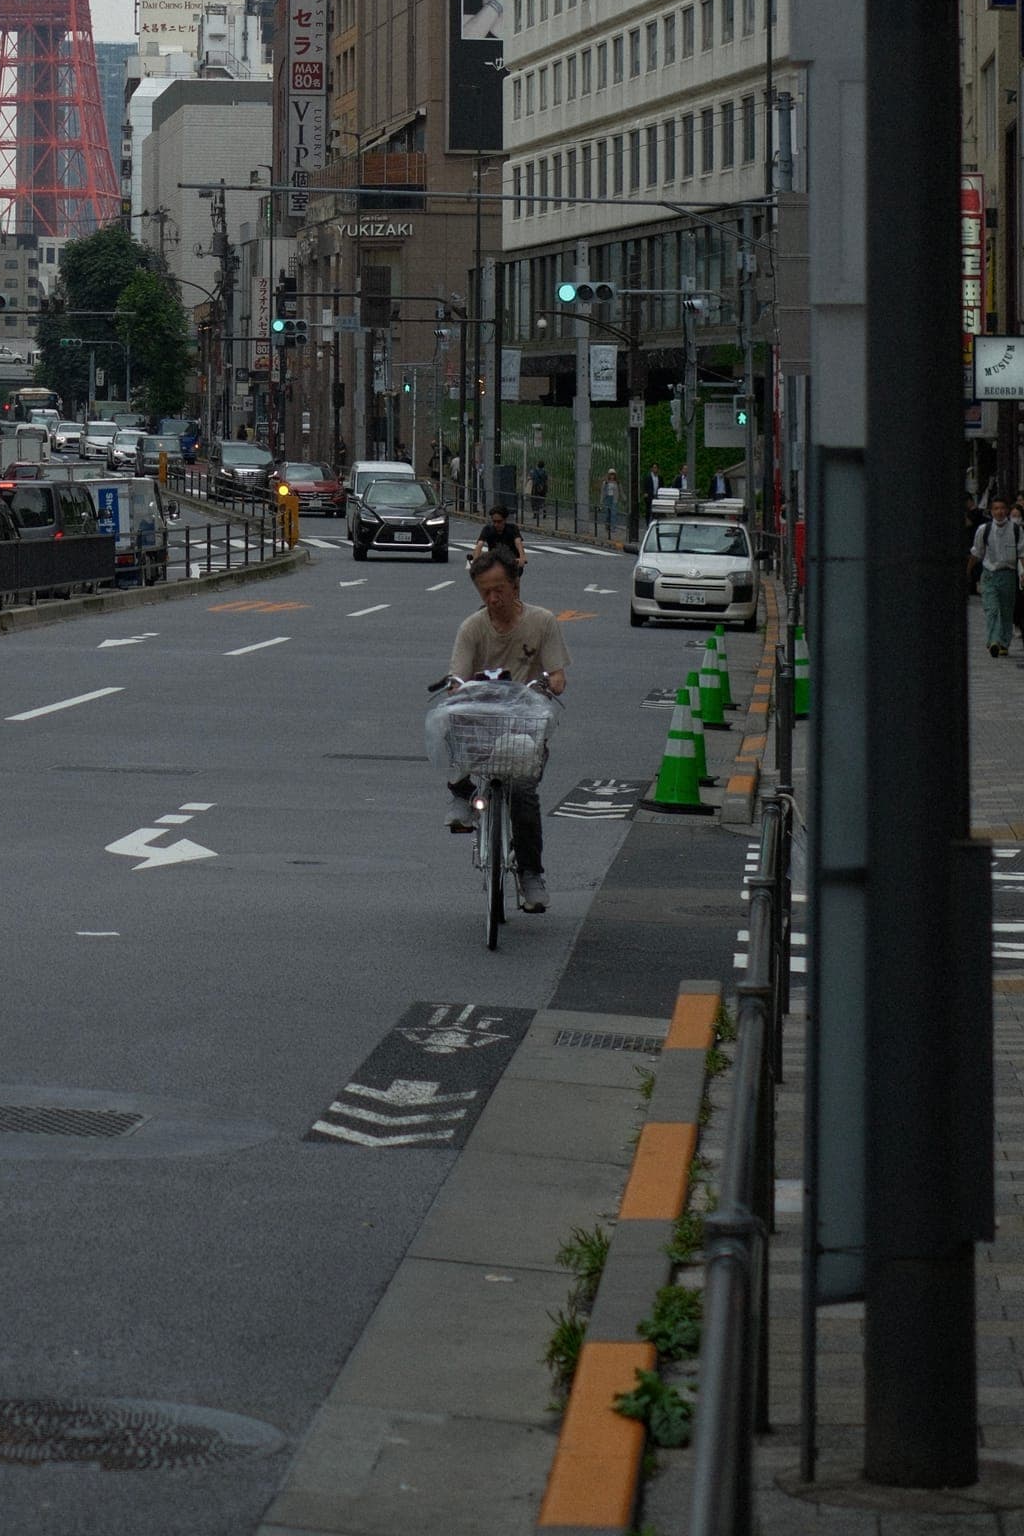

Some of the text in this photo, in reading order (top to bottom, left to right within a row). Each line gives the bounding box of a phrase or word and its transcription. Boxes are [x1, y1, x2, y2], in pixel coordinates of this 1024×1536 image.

[295, 64, 321, 74] MAX
[294, 74, 321, 88] 80名
[314, 109, 322, 161] LUXURY
[337, 223, 414, 237] YUKIZAKI
[984, 344, 1015, 377] MUSIUM
[984, 386, 1017, 396] RECORD
